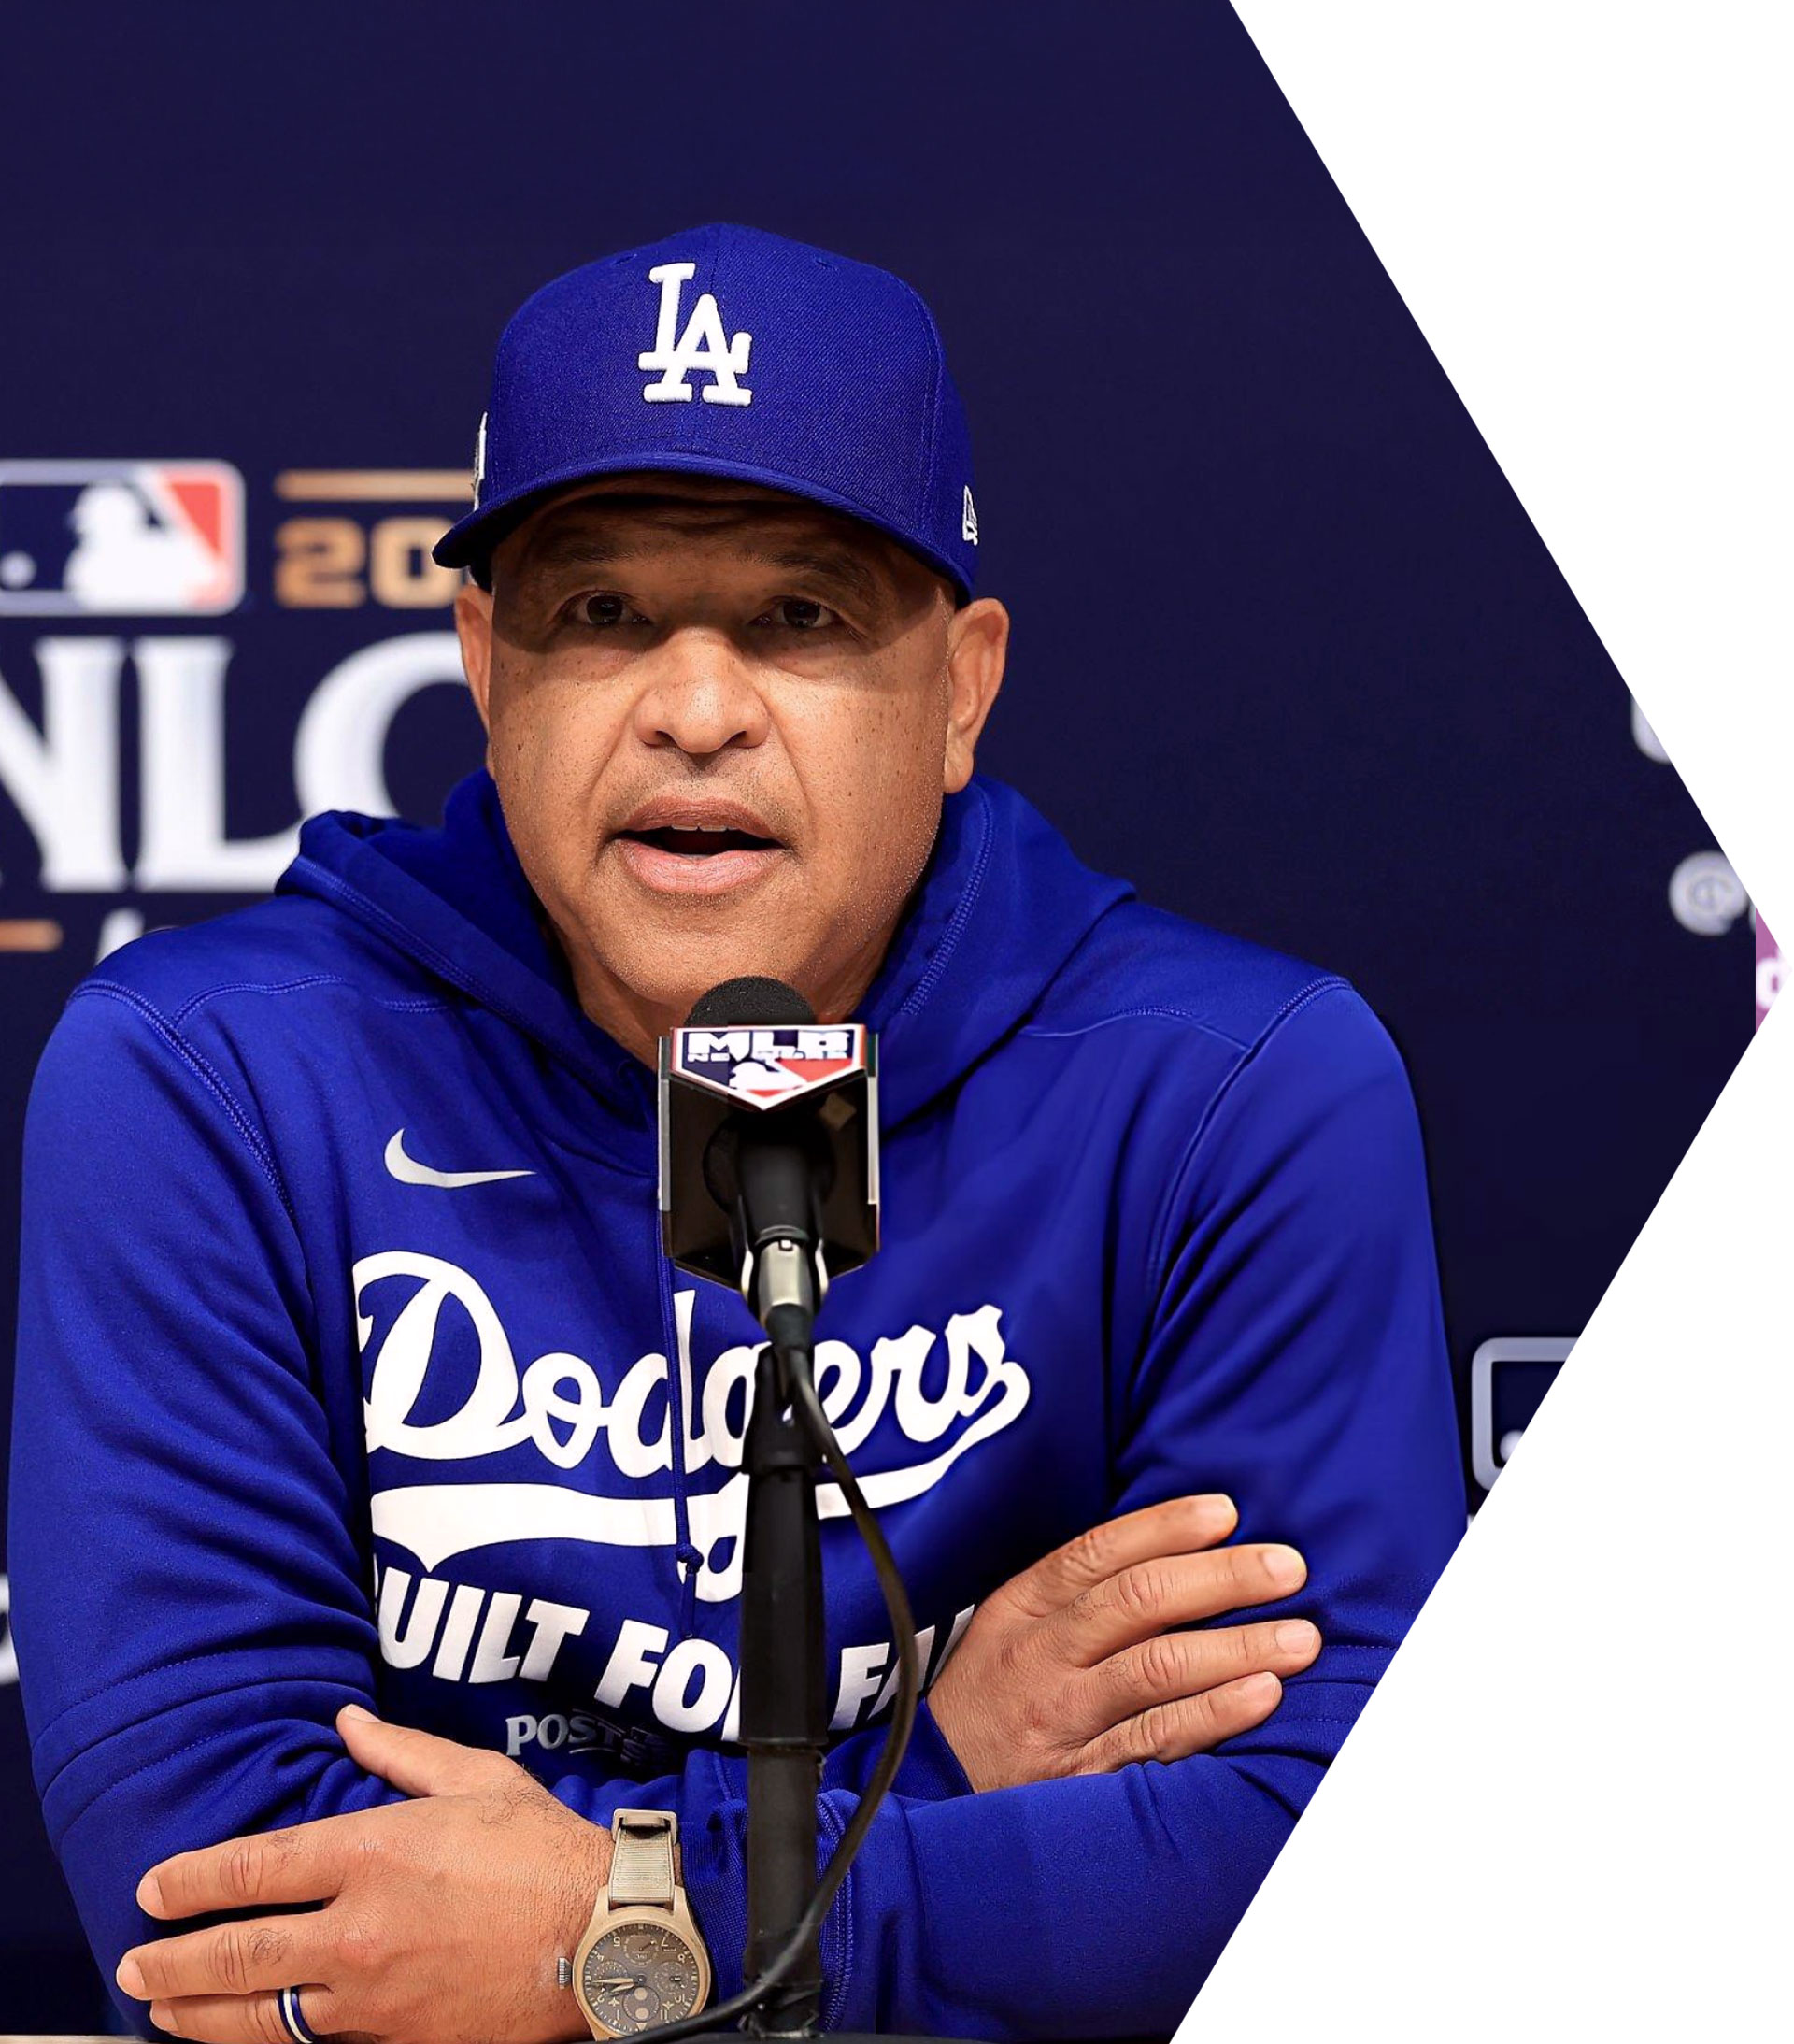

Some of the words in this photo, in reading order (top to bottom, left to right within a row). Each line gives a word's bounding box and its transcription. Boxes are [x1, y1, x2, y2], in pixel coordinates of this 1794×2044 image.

[638, 262, 753, 407] LA
[352, 1251, 1030, 1603] Dodgers
[374, 1553, 591, 1684] UILT
[594, 1619, 741, 1743] FO
[828, 1604, 975, 1731] FA
